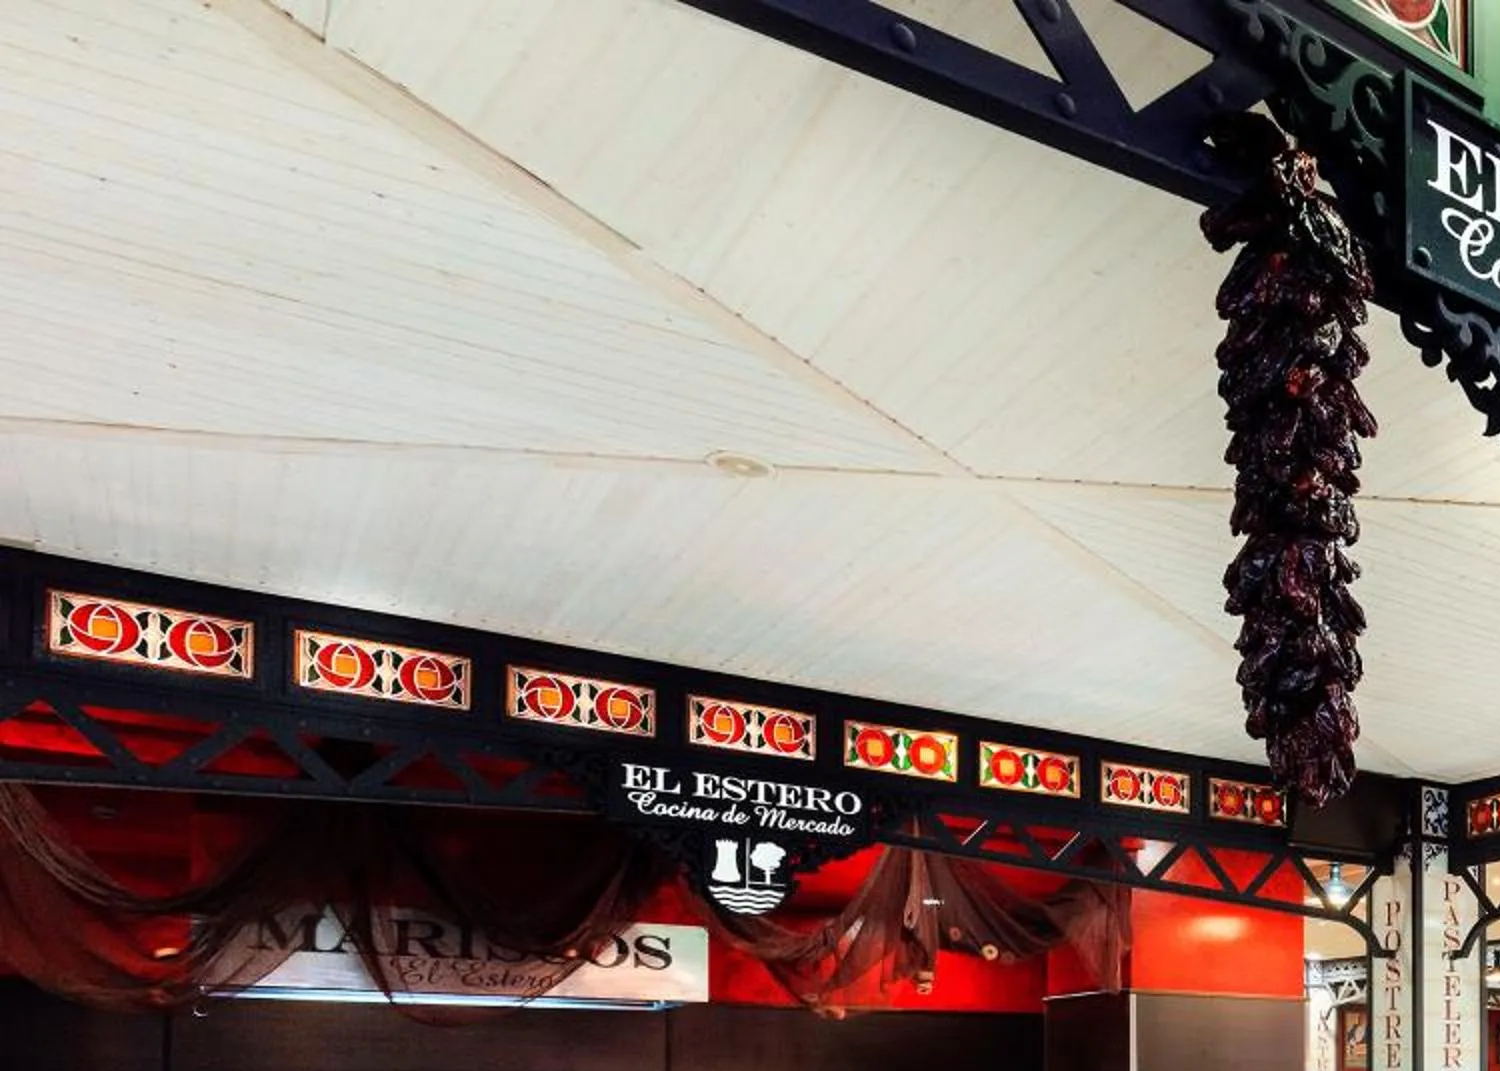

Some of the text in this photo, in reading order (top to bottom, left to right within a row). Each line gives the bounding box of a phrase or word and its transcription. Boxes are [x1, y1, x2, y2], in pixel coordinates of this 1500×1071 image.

[621, 763, 862, 815] EL ESTERO
[627, 792, 855, 836] Cocina de Mercado
[246, 914, 673, 972] MARISOS
